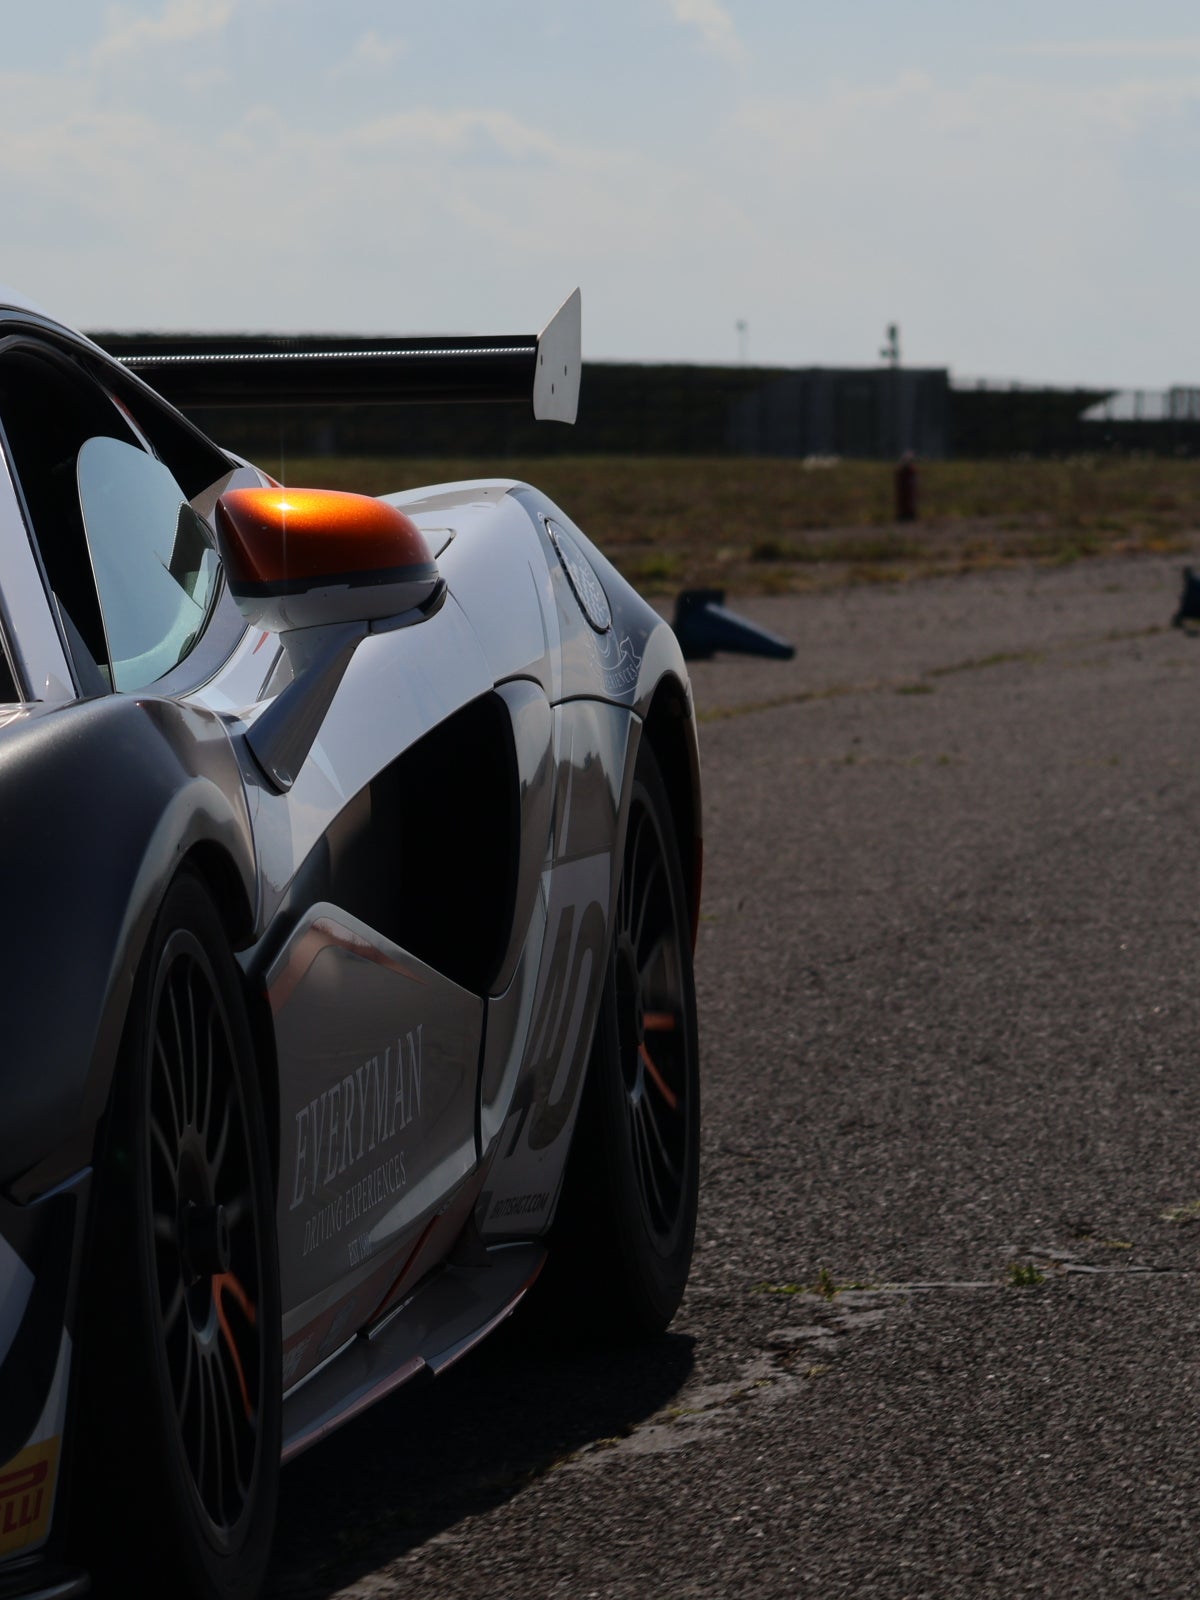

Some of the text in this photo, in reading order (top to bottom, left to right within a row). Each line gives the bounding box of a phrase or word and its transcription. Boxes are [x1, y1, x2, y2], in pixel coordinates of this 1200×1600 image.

[289, 1023, 423, 1211] EVERYMAN
[302, 1196, 344, 1257] DRIVING
[343, 1151, 407, 1225] EXPERIENCES
